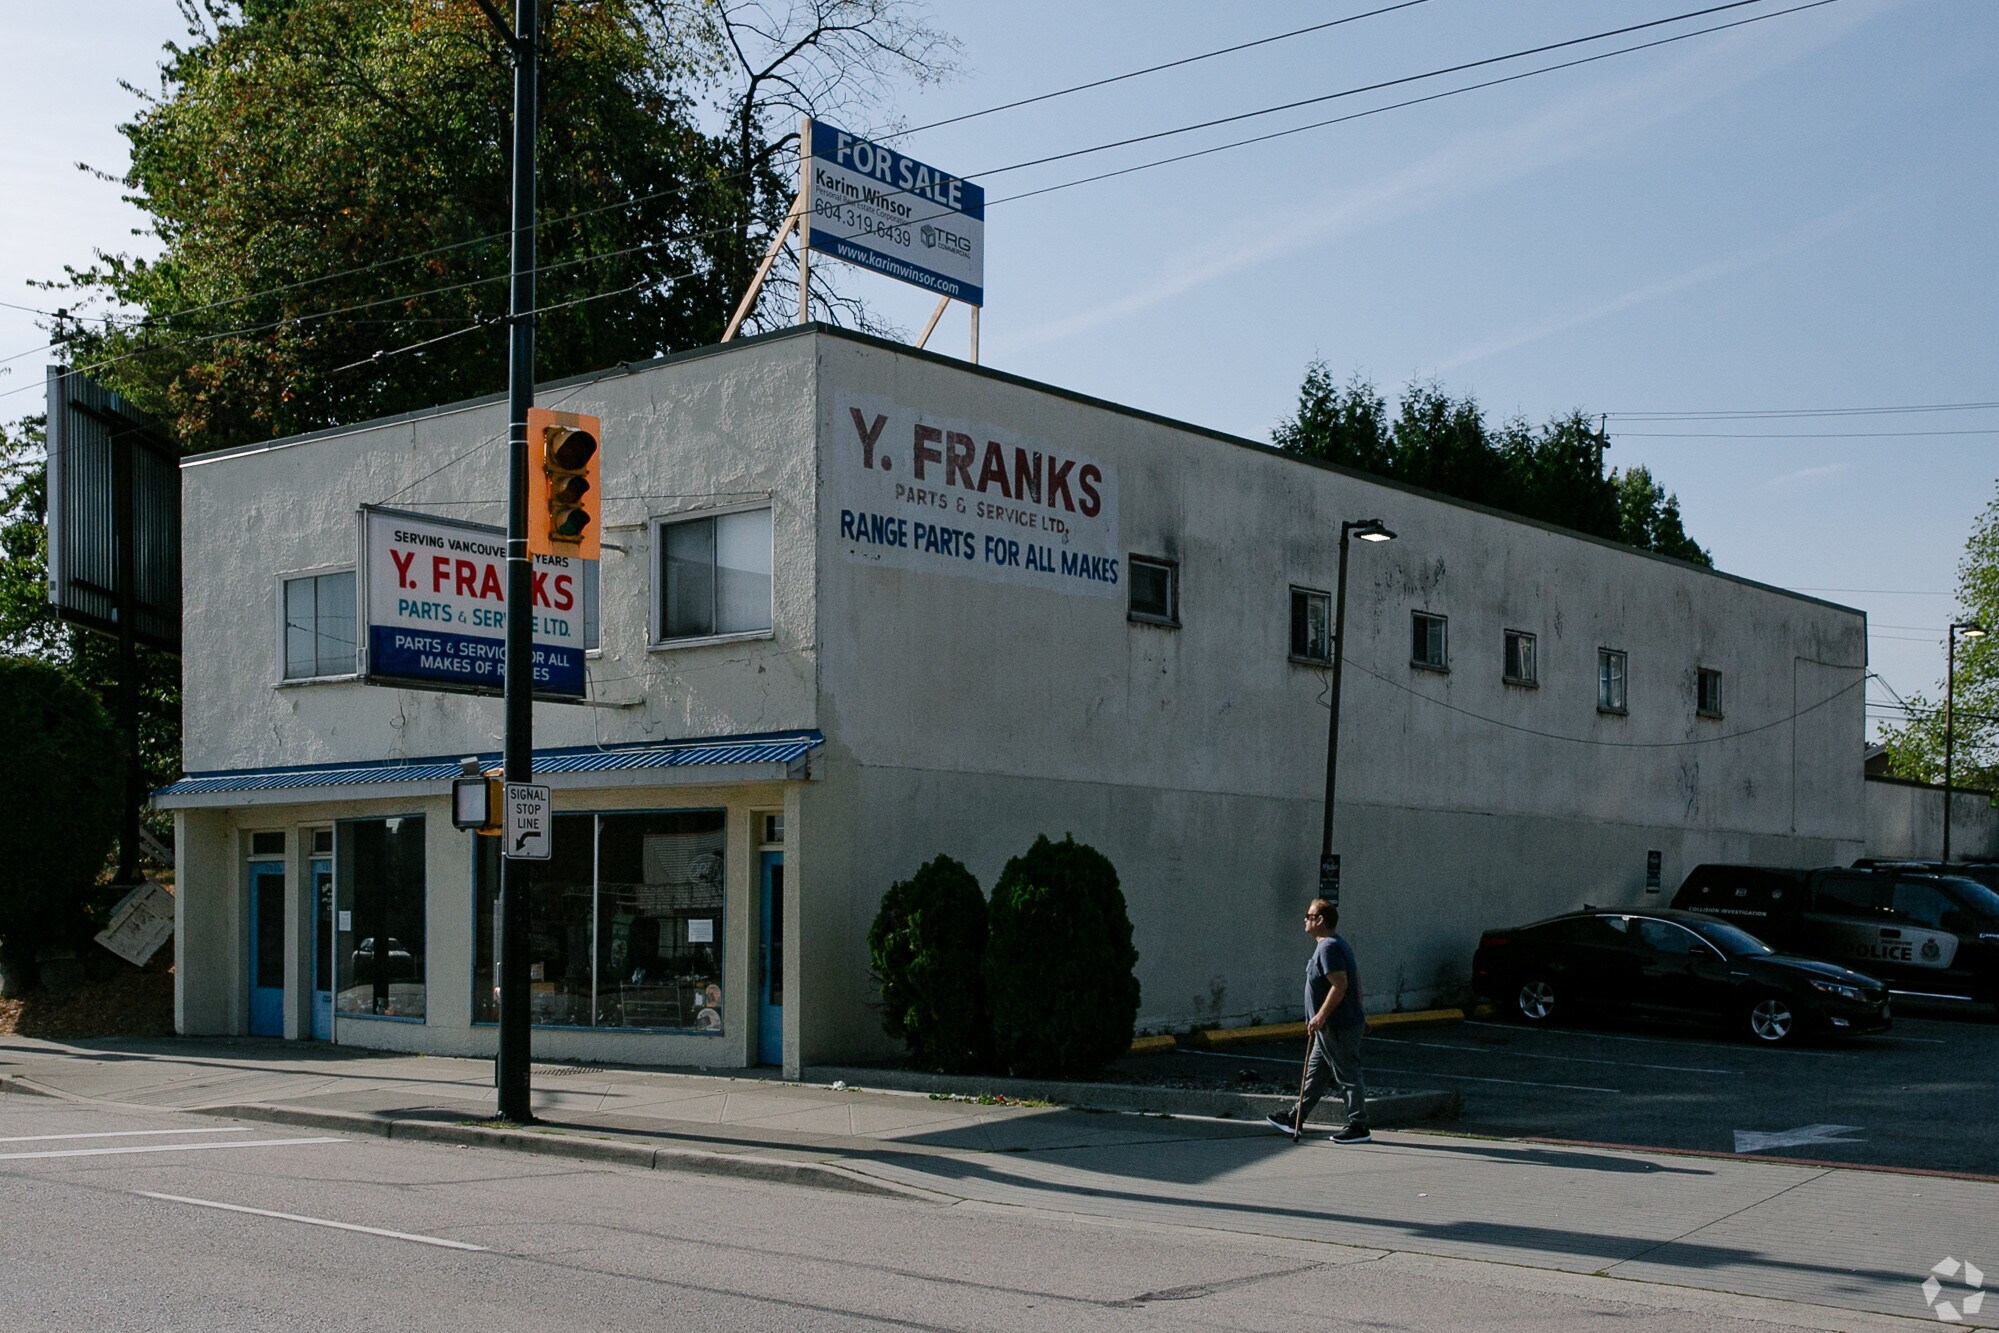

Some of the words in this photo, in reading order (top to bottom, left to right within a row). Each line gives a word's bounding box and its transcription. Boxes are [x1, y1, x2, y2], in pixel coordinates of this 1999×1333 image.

[837, 132, 892, 183] FOR
[899, 159, 963, 210] SALE
[815, 185, 842, 202] Personal
[816, 168, 859, 200] Karim
[862, 186, 912, 218] Winsor
[815, 197, 911, 248] 604.319.6439
[934, 227, 971, 252] TRG
[837, 243, 959, 295] www.karimwinsor.com
[849, 406, 893, 472] Y.
[913, 423, 1103, 518] FRANKS
[895, 483, 948, 510] PARTS
[956, 497, 966, 514] &
[976, 501, 1037, 528] SERVICE
[1042, 515, 1070, 535] LTD.
[394, 530, 445, 549] SERVING
[448, 539, 506, 558] VANCOUVE
[535, 554, 569, 568] YEARS
[840, 509, 908, 548] RANGE
[913, 522, 976, 561] PARTS
[984, 535, 1021, 567] FOR
[1025, 543, 1056, 574] ALL
[1061, 550, 1119, 585] MAKES
[389, 548, 417, 590] Y.
[432, 555, 574, 611] FRAKS
[398, 598, 452, 622] PARTS
[458, 611, 467, 624] &
[472, 608, 538, 633] SERE
[544, 619, 571, 637] LTD.
[395, 635, 441, 652] PARTS
[446, 642, 454, 654] &
[459, 642, 506, 661] SERVIC
[548, 652, 570, 667] ALL
[420, 655, 471, 673] MAKES
[475, 660, 492, 674] OF
[497, 663, 550, 681] RES
[510, 788, 546, 801] SIGNAL
[516, 803, 542, 815] STOP
[517, 818, 540, 829] LINE
[1720, 907, 1768, 917] INVESTIGATION
[1842, 942, 1912, 961] POLICE
